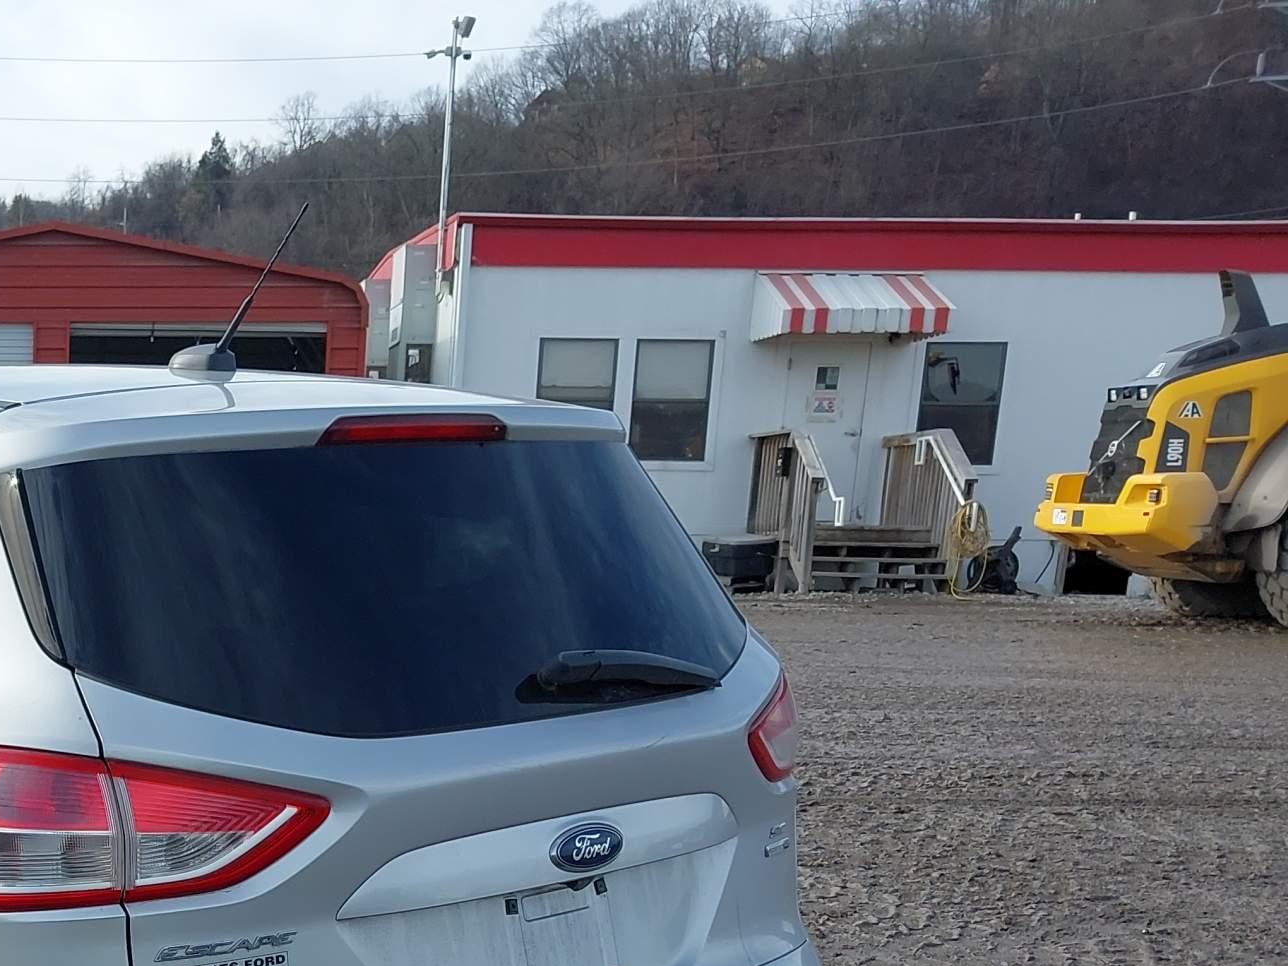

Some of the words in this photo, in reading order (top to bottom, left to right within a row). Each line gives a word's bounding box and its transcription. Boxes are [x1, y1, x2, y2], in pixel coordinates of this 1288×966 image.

[1166, 439, 1185, 466] L90H
[573, 833, 611, 861] Ford
[154, 931, 298, 962] ESCAPE
